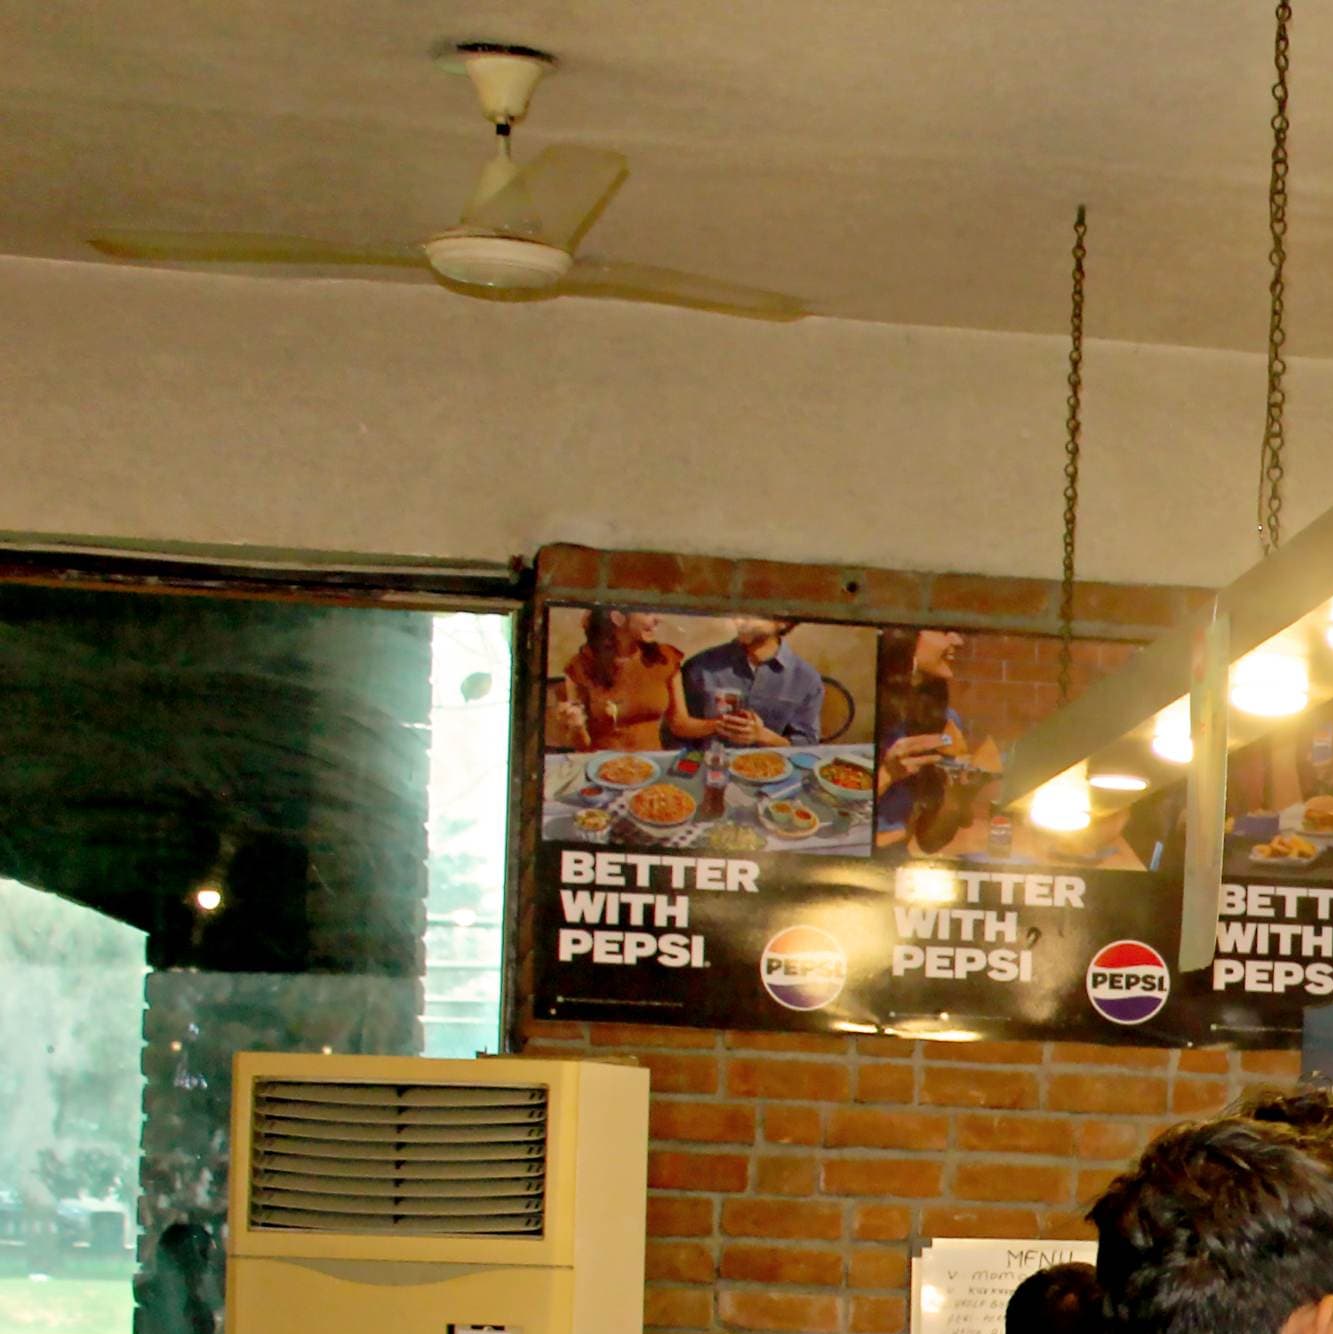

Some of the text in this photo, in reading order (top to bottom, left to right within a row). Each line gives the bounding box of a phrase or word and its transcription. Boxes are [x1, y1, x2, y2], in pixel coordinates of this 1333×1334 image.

[560, 850, 759, 892] BETTER
[895, 868, 1086, 909] BETTER
[560, 890, 689, 929] WITH
[894, 908, 1018, 943] WITH
[557, 929, 704, 968] PEPSI
[1216, 922, 1333, 958] WITH
[893, 945, 1031, 982] PEPSI
[1090, 972, 1166, 992] PEPSI
